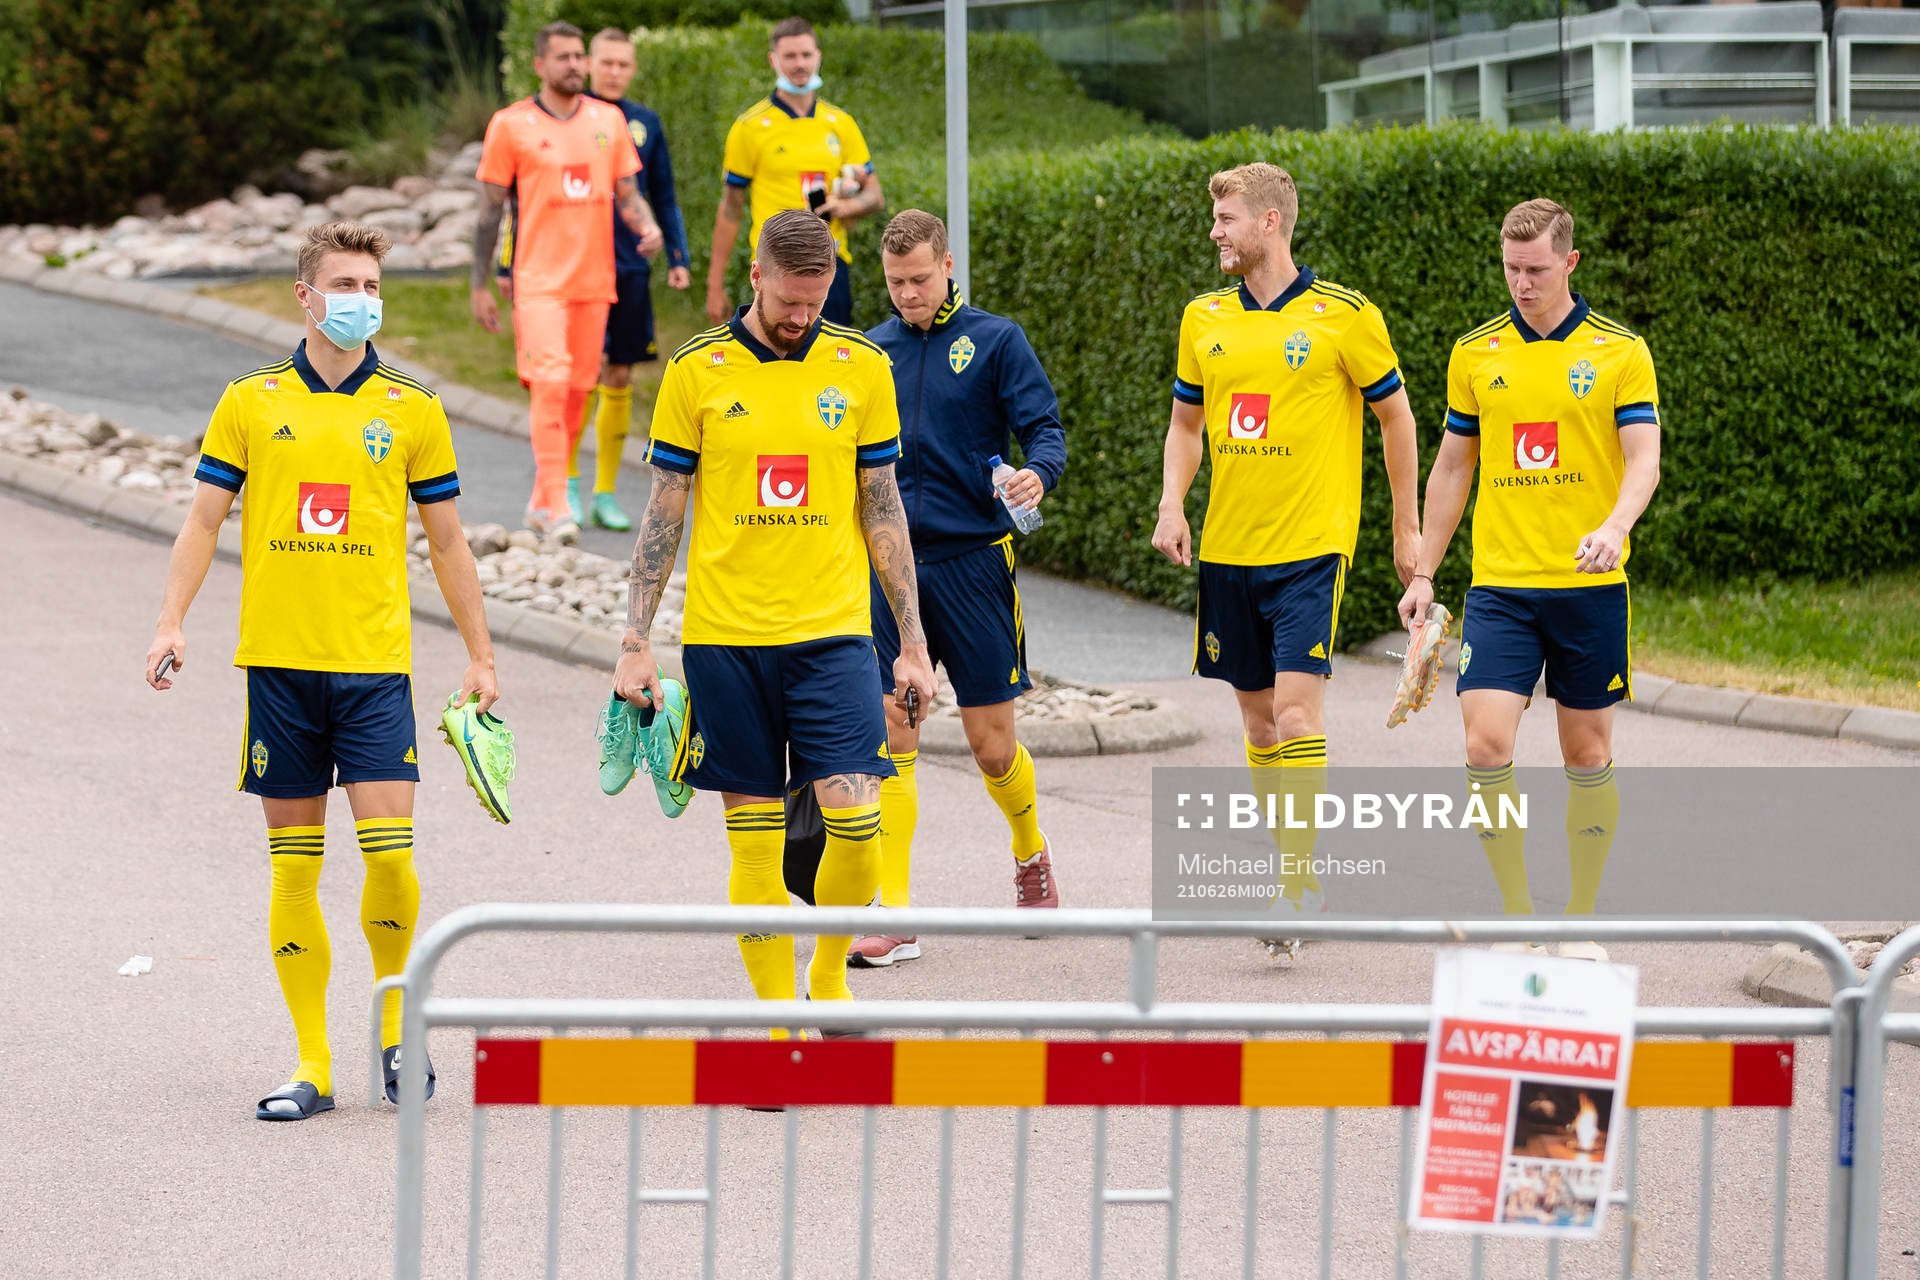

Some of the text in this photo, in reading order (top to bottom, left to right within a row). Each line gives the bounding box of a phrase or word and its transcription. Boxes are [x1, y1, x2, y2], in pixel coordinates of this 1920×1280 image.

[724, 410, 749, 419] adidas
[271, 433, 296, 441] adidas
[1216, 444, 1292, 456] VENSKA SPEL
[1493, 472, 1585, 488] SVENSKA SPEL
[733, 514, 829, 526] SVENSKA SPEL
[269, 539, 375, 556] SVENSKA SPEL
[1445, 1028, 1615, 1068] AVSPÄRRAT
